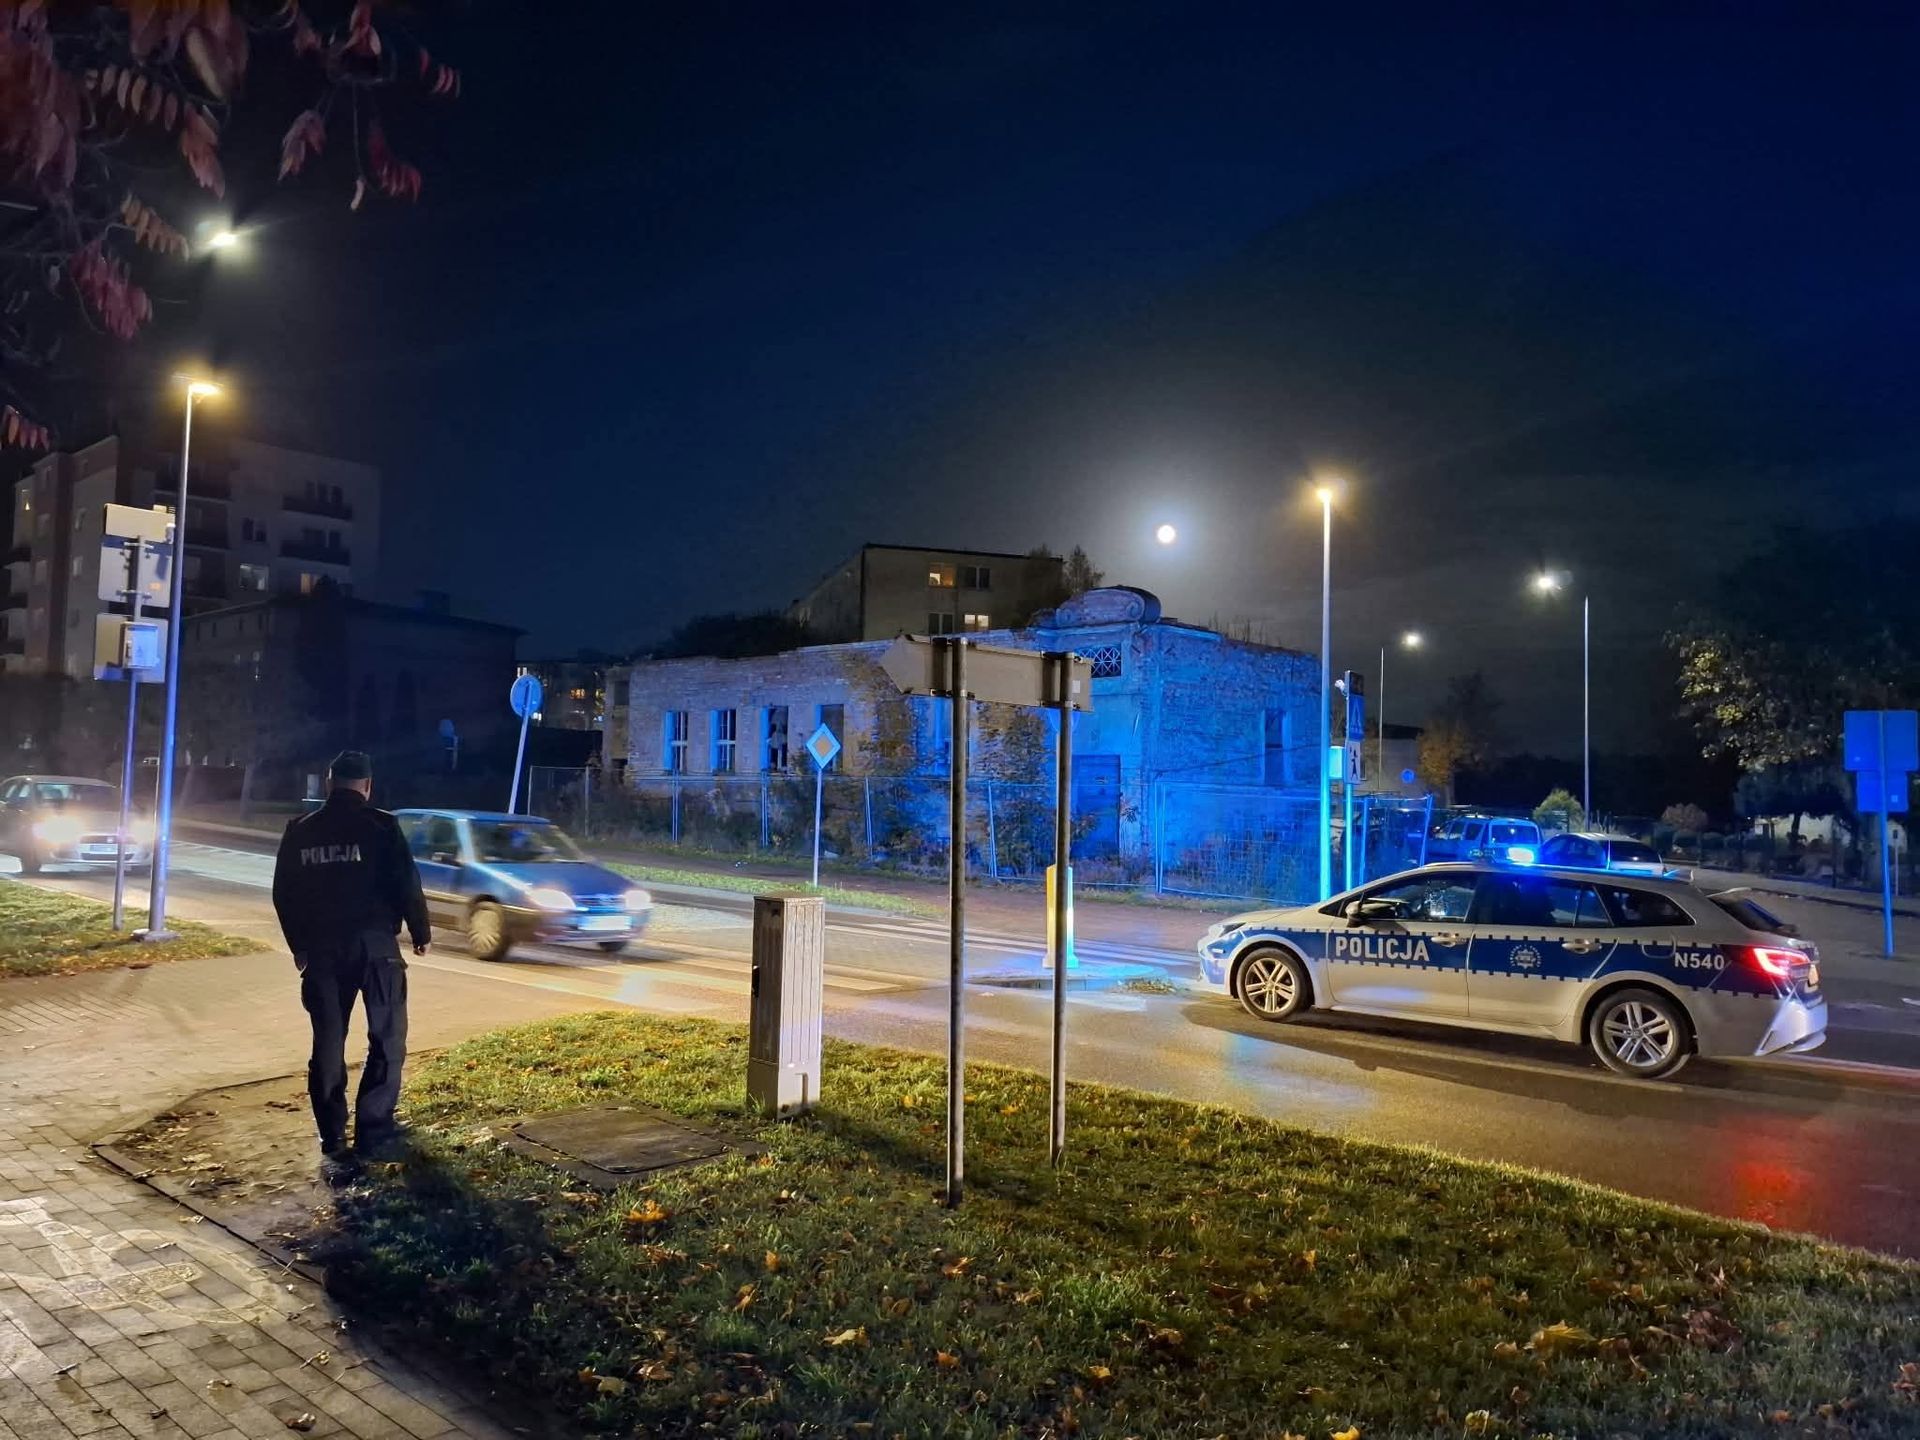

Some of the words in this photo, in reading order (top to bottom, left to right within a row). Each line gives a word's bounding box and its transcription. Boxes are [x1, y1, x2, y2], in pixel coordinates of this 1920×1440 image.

[300, 844, 361, 866] POLICJA
[1335, 936, 1430, 961] POLICJA
[1674, 952, 1725, 970] N540
